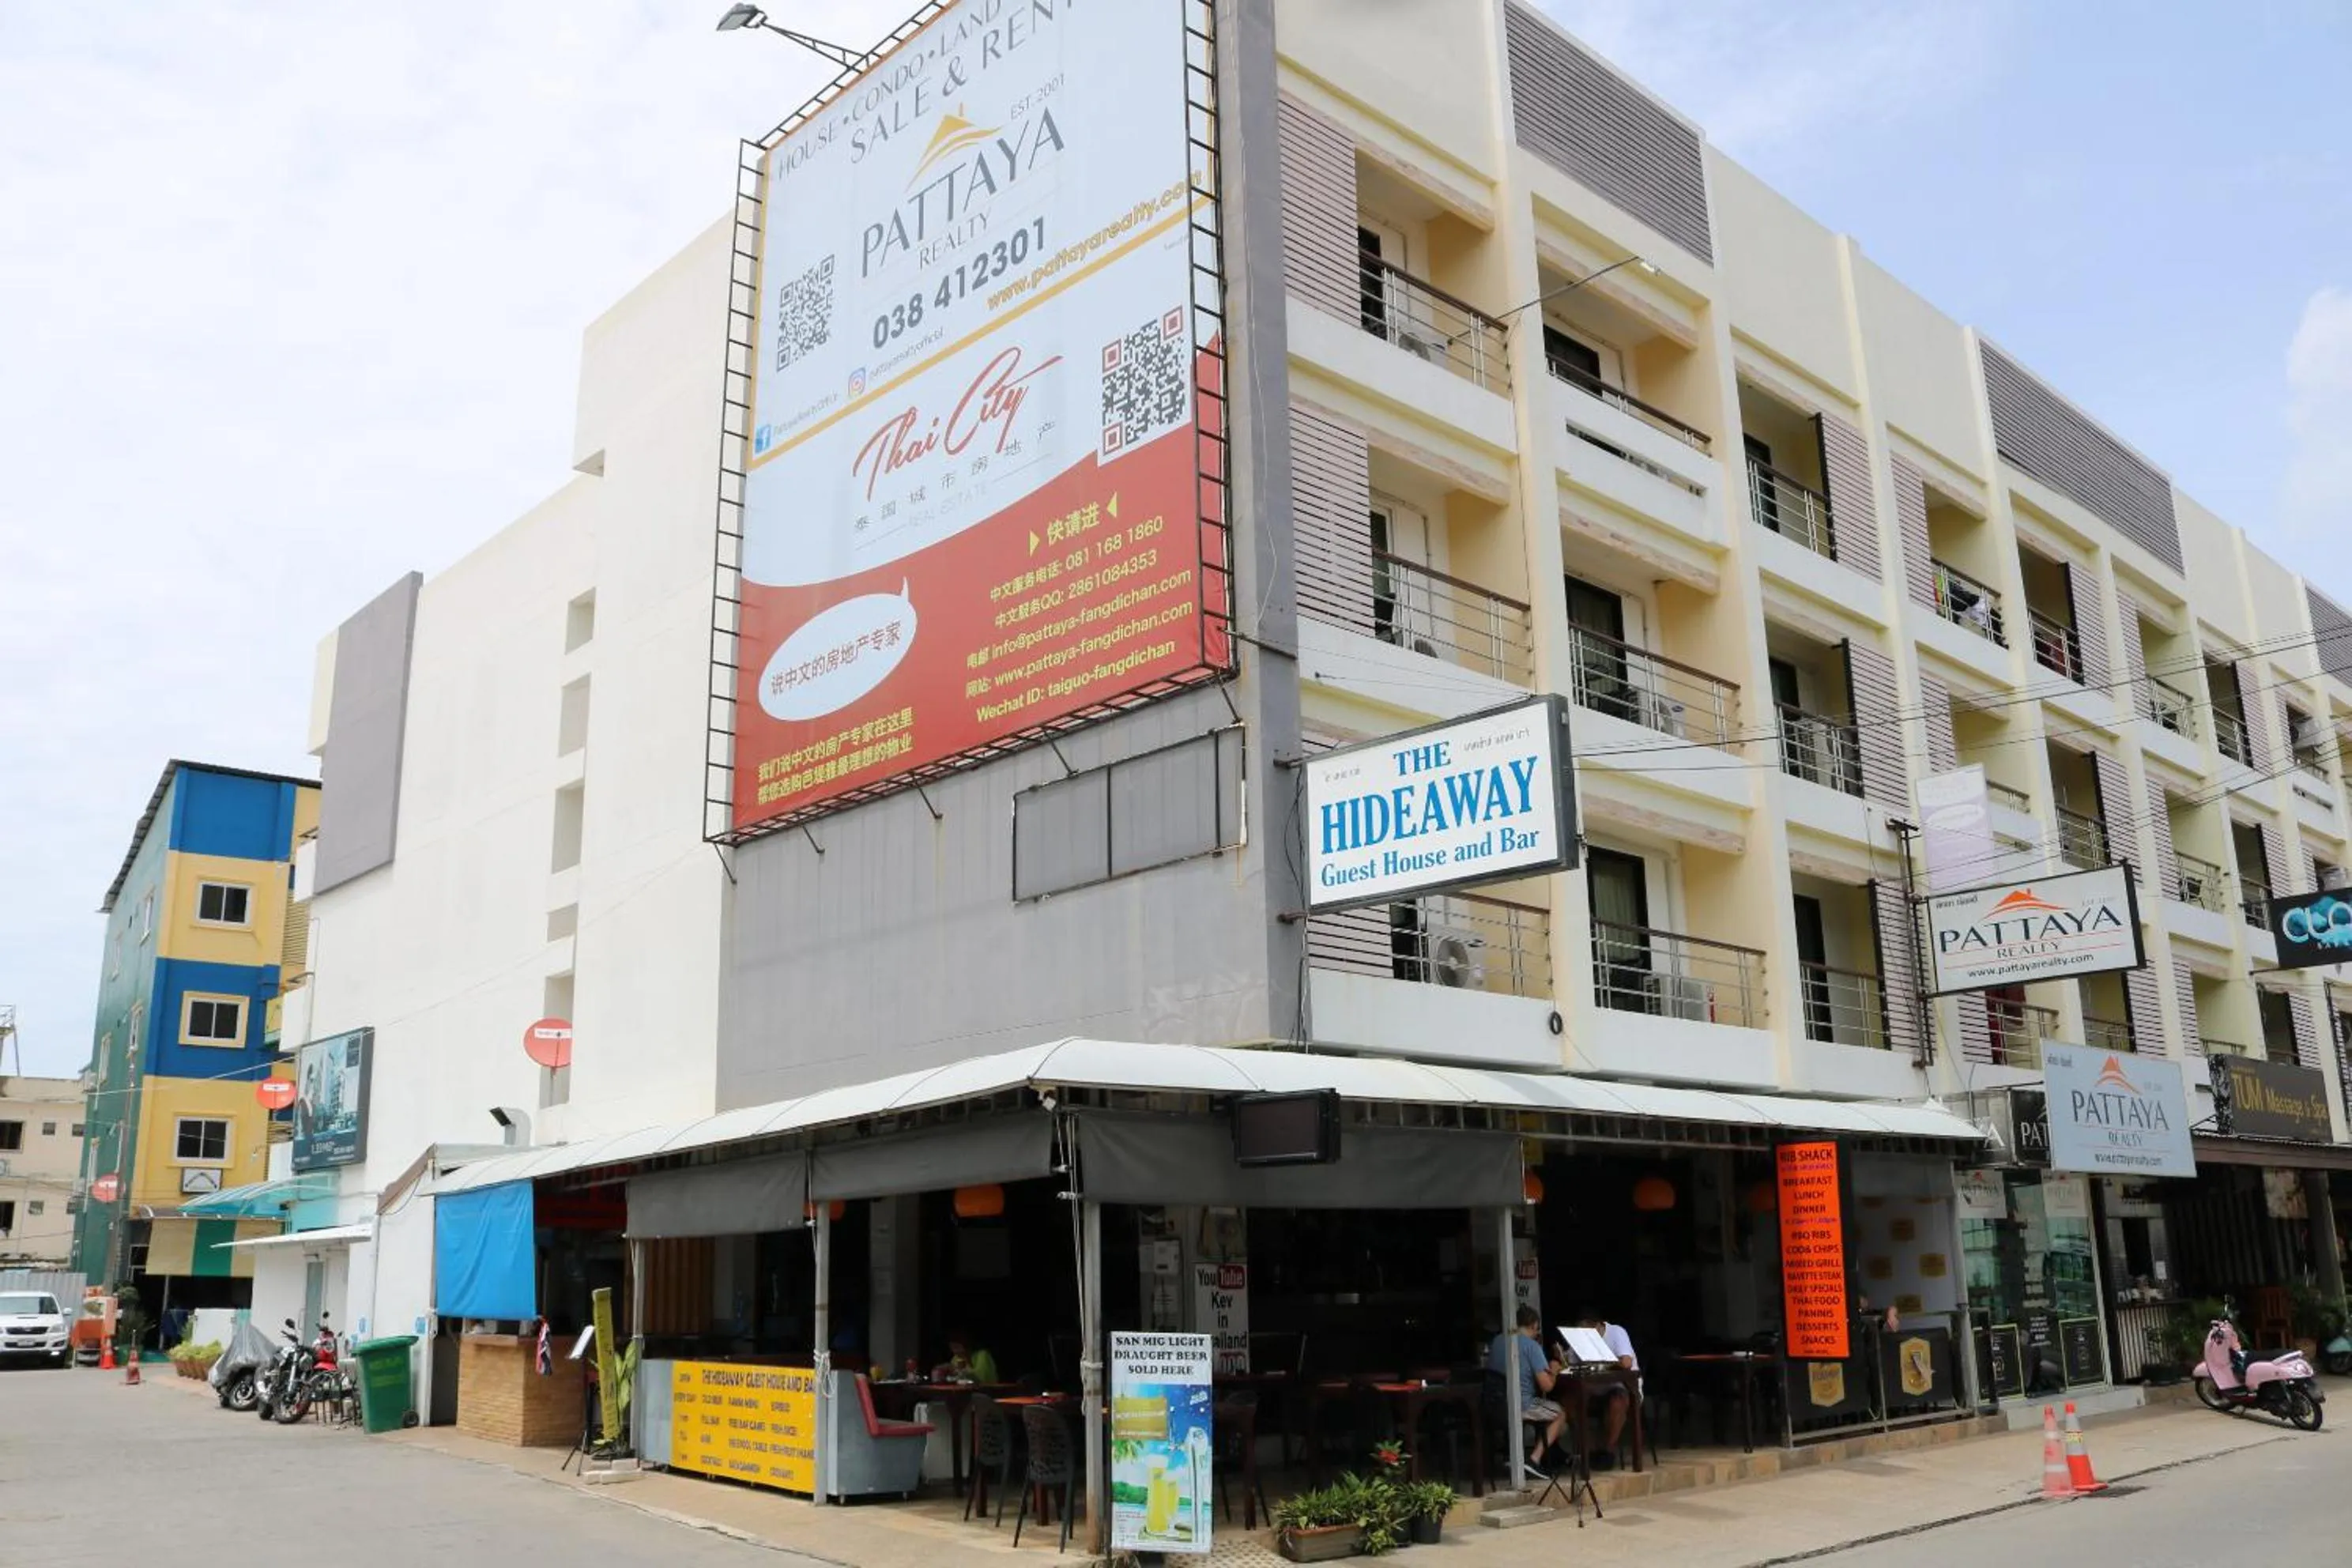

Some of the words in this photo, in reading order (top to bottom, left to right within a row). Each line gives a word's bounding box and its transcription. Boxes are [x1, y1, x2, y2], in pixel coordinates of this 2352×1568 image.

[851, 77, 931, 164] SALE
[942, 55, 968, 96] &
[982, 0, 1072, 70] REN
[778, 119, 844, 182] HOUSE
[852, 53, 925, 122] CONDO
[861, 107, 1065, 278] PATTAYA
[918, 209, 991, 272] REALTY
[873, 293, 924, 349] 038
[933, 217, 1045, 309] 412301
[853, 406, 940, 502] Thai
[944, 346, 1064, 455] City
[1066, 546, 1090, 570] 081
[1096, 533, 1122, 558] 168
[1125, 515, 1163, 545] 1860
[1069, 549, 1158, 600] 2861084353
[993, 570, 1192, 659] info@pattaya-fangdichan.com
[995, 601, 1193, 688] www.pattaya-fangdichan.com
[976, 694, 1024, 722] Wechat
[1027, 687, 1045, 706] ID:
[1048, 640, 1176, 697] taiguo-fangdichan
[1393, 741, 1452, 776] THE
[1321, 756, 1538, 855] HIDEAWAY
[1321, 858, 1376, 887] Guest
[1383, 849, 1448, 876] House
[1454, 831, 1492, 861] and
[1499, 827, 1540, 853] Bar
[1939, 904, 2122, 953] PATTAYA
[1997, 940, 2060, 959] REALTY
[1967, 953, 2094, 978] www.pattayarealty.com
[2071, 1090, 2170, 1131] PATTAYA
[2108, 1131, 2144, 1147] REALTY
[1798, 1148, 1833, 1161] SHACK
[1783, 1176, 1833, 1186] BREAKFAST
[1794, 1191, 1824, 1200] LUNCH
[1792, 1204, 1826, 1214] DINNER
[1811, 1230, 1832, 1239] RIBS
[1813, 1244, 1839, 1253] CHIPS
[1815, 1258, 1840, 1268] GRILL
[1814, 1295, 1840, 1305] FOOD
[1217, 1311, 1228, 1329] in
[1795, 1322, 1840, 1332] DESSERTS
[1115, 1336, 1140, 1345] SAN
[1143, 1336, 1165, 1346] MIG
[1168, 1337, 1205, 1347] LIGHT
[1212, 1332, 1247, 1349] ailand
[1800, 1336, 1836, 1344] SNACKS
[1114, 1350, 1174, 1360] DRAUGHT
[1176, 1351, 1208, 1361] BEER
[1128, 1365, 1158, 1374] SOLD
[1161, 1366, 1194, 1375] HERE
[804, 1376, 815, 1393] BA
